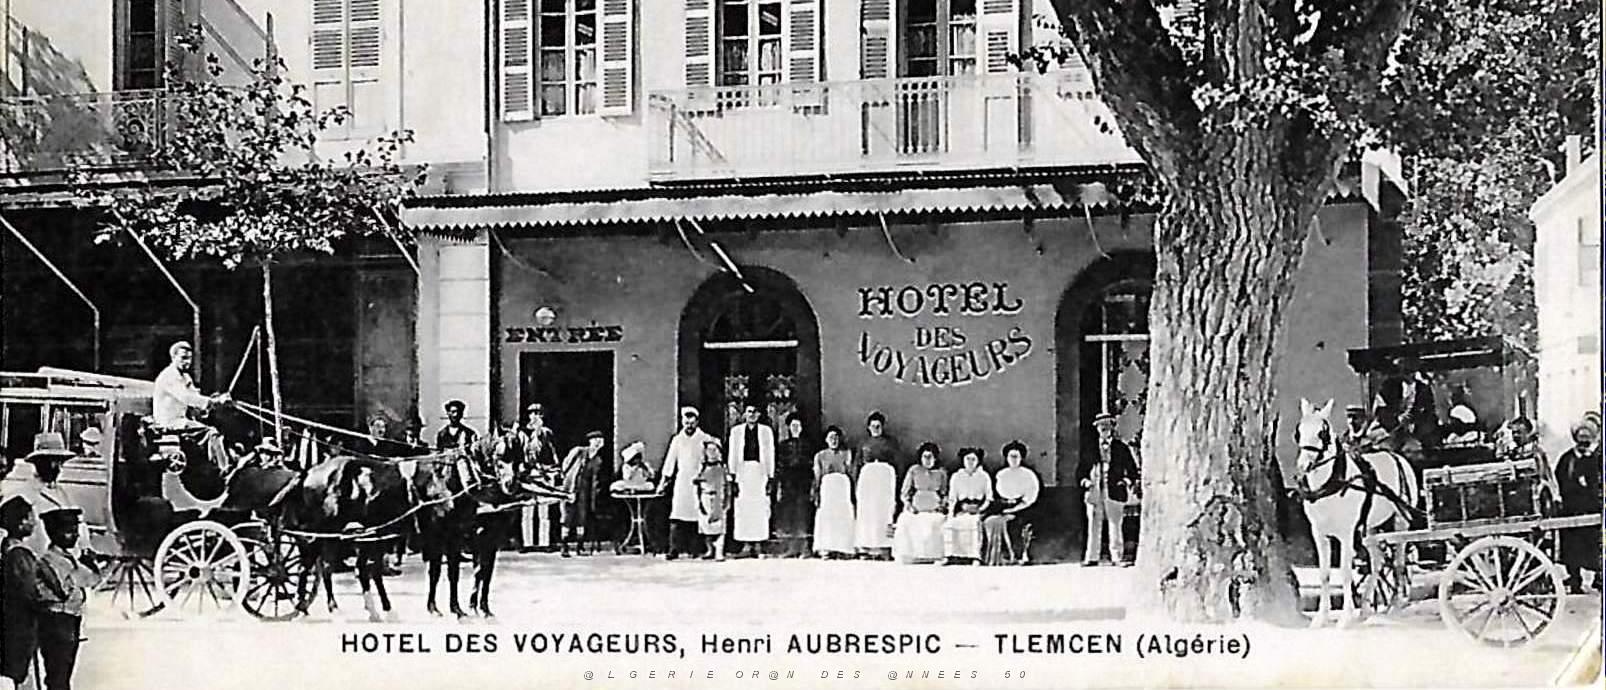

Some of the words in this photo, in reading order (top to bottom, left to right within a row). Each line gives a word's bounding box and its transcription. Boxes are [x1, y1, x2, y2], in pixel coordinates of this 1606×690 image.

[858, 282, 1024, 317] HOTEL
[916, 326, 968, 349] DES
[857, 326, 1033, 387] VOYAGEURS
